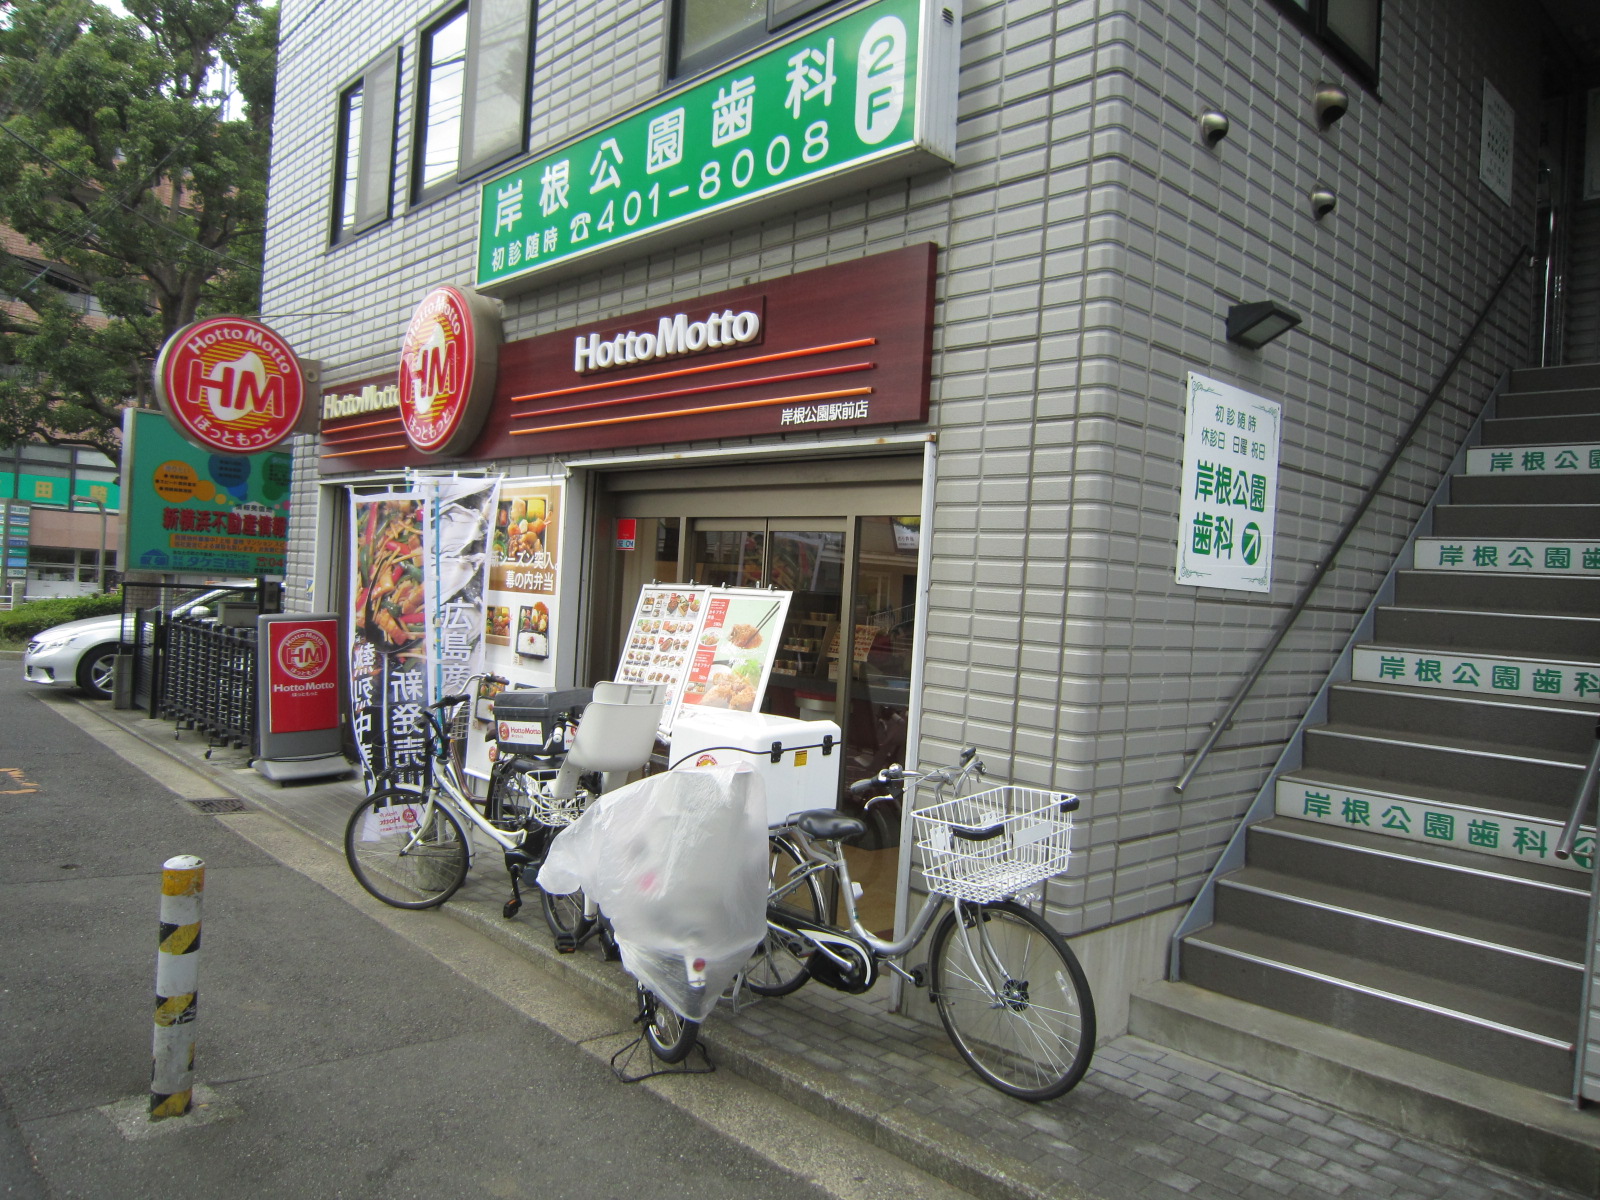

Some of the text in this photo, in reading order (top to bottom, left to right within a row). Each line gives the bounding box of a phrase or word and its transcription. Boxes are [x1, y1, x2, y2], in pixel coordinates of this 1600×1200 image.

[865, 33, 895, 132] 2F
[495, 37, 837, 238] 岸根公園歯科
[597, 120, 829, 233] 401-8008
[491, 226, 558, 273] 初診随時
[186, 358, 285, 419] HM
[404, 340, 457, 404] HM
[193, 414, 277, 445] ほっともっと
[780, 399, 869, 426] 岸根公園駅前店
[1214, 403, 1257, 433] 初診随時
[1201, 426, 1266, 461] 休診日 日曜 祝日
[1194, 458, 1267, 513] 岸根公園
[1192, 511, 1234, 560] 歯科
[505, 569, 554, 592] 幕の内弁当
[286, 646, 323, 664] HM
[1378, 655, 1600, 700] 岸根公園歯科
[1302, 789, 1549, 859] 岸根公園歯科
